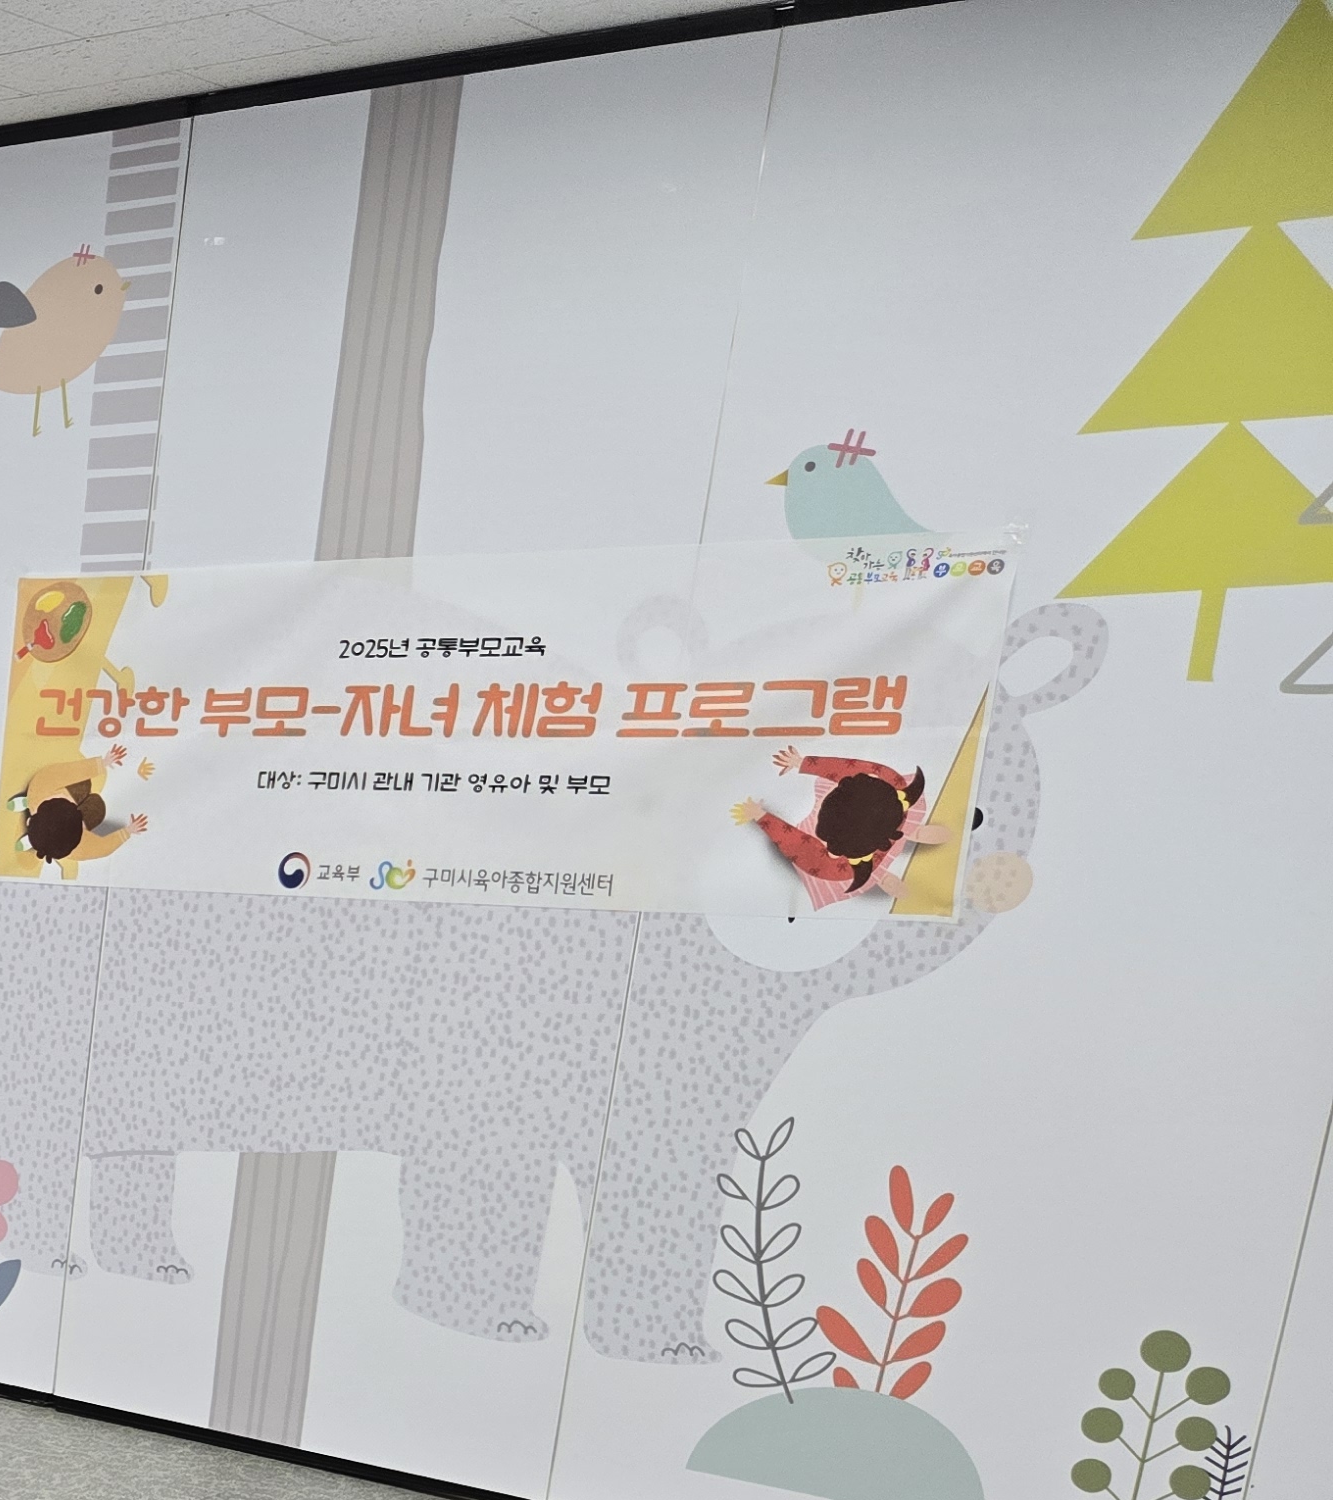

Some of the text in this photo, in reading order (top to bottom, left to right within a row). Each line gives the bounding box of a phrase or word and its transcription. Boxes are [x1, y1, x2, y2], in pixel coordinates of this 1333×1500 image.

[338, 636, 546, 659] 2025년 공통부모교육
[35, 675, 908, 738] 건강한 부모-자녀 체험 프로그램
[257, 771, 611, 795] 대상: 구미시 관내 기관 영유아 및 부모
[316, 864, 614, 897] 교육부 구미시육아종합지원센터
